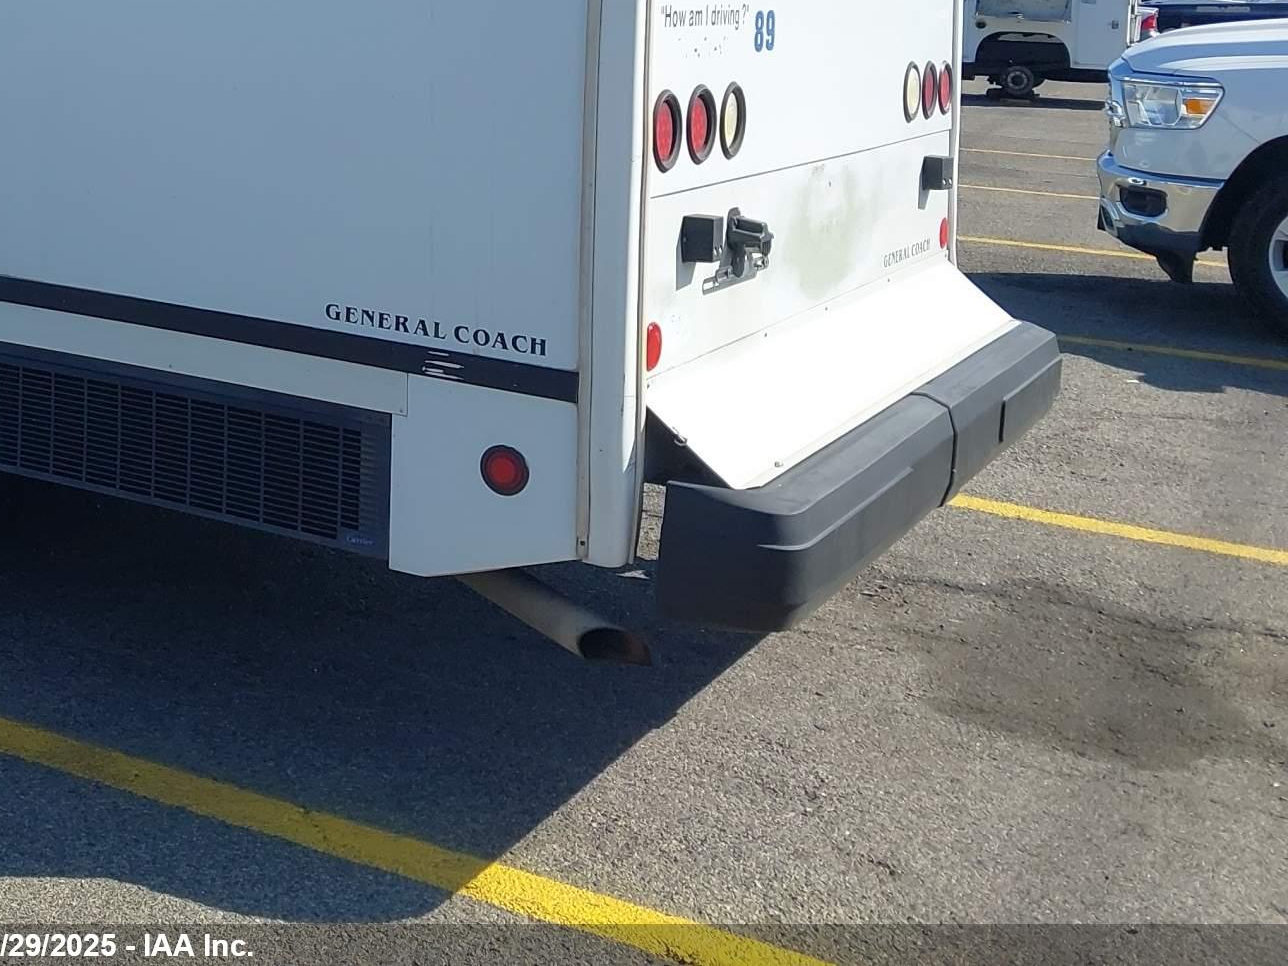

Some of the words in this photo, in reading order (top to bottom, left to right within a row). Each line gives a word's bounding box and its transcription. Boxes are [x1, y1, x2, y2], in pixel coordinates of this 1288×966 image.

[688, 9, 704, 27] am
[754, 9, 776, 53] 89
[911, 238, 931, 256] COACH
[325, 303, 448, 339] GENERAL
[453, 325, 547, 357] COACH
